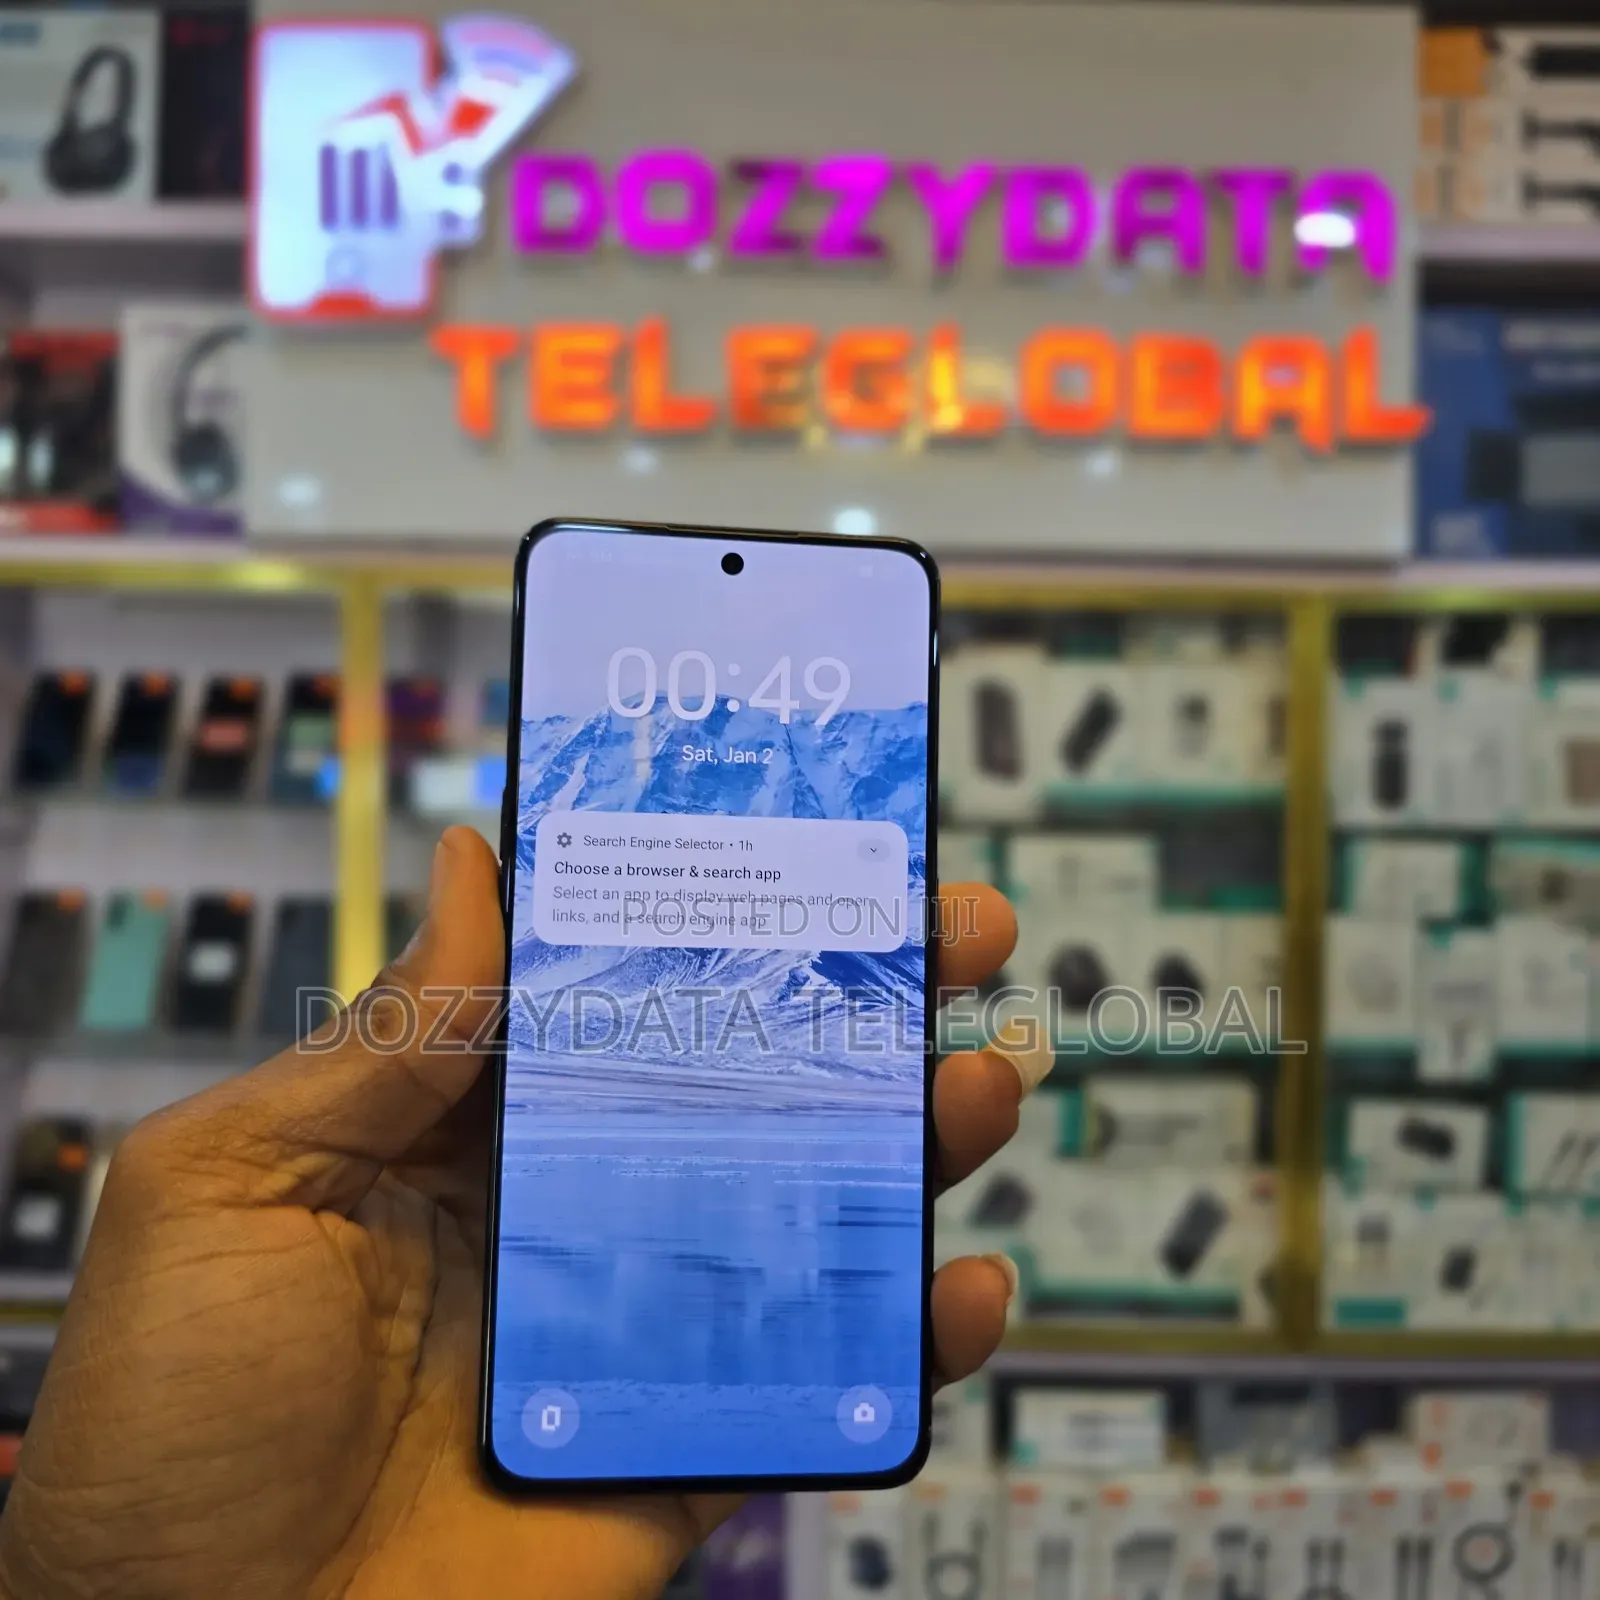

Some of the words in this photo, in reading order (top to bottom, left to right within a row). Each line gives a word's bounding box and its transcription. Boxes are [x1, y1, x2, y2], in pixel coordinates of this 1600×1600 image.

[510, 149, 1398, 282] DOZZYDATA
[432, 318, 1430, 448] TELEGLOBAL
[607, 646, 851, 727] 00:49
[682, 745, 718, 765] Sat,
[723, 747, 757, 764] Jan
[762, 748, 773, 764] 2
[583, 835, 626, 847] Search
[630, 837, 671, 850] Engine
[674, 838, 724, 850] Selector
[738, 840, 753, 852] 1h
[554, 861, 610, 875] Choose
[614, 865, 622, 876] a
[627, 863, 685, 877] browser
[689, 865, 699, 878] &
[703, 866, 751, 880] search
[755, 869, 781, 883] app
[553, 886, 598, 899] Select
[602, 889, 620, 900] an
[624, 890, 650, 904] app
[655, 889, 669, 902] to
[673, 888, 724, 907] display
[727, 890, 756, 904] web
[760, 893, 802, 908] pages
[807, 892, 833, 905] and
[552, 909, 588, 925] links,
[593, 910, 620, 923] and
[624, 913, 632, 924] a
[637, 912, 685, 926] search
[689, 914, 736, 928] engine
[740, 915, 767, 929] app
